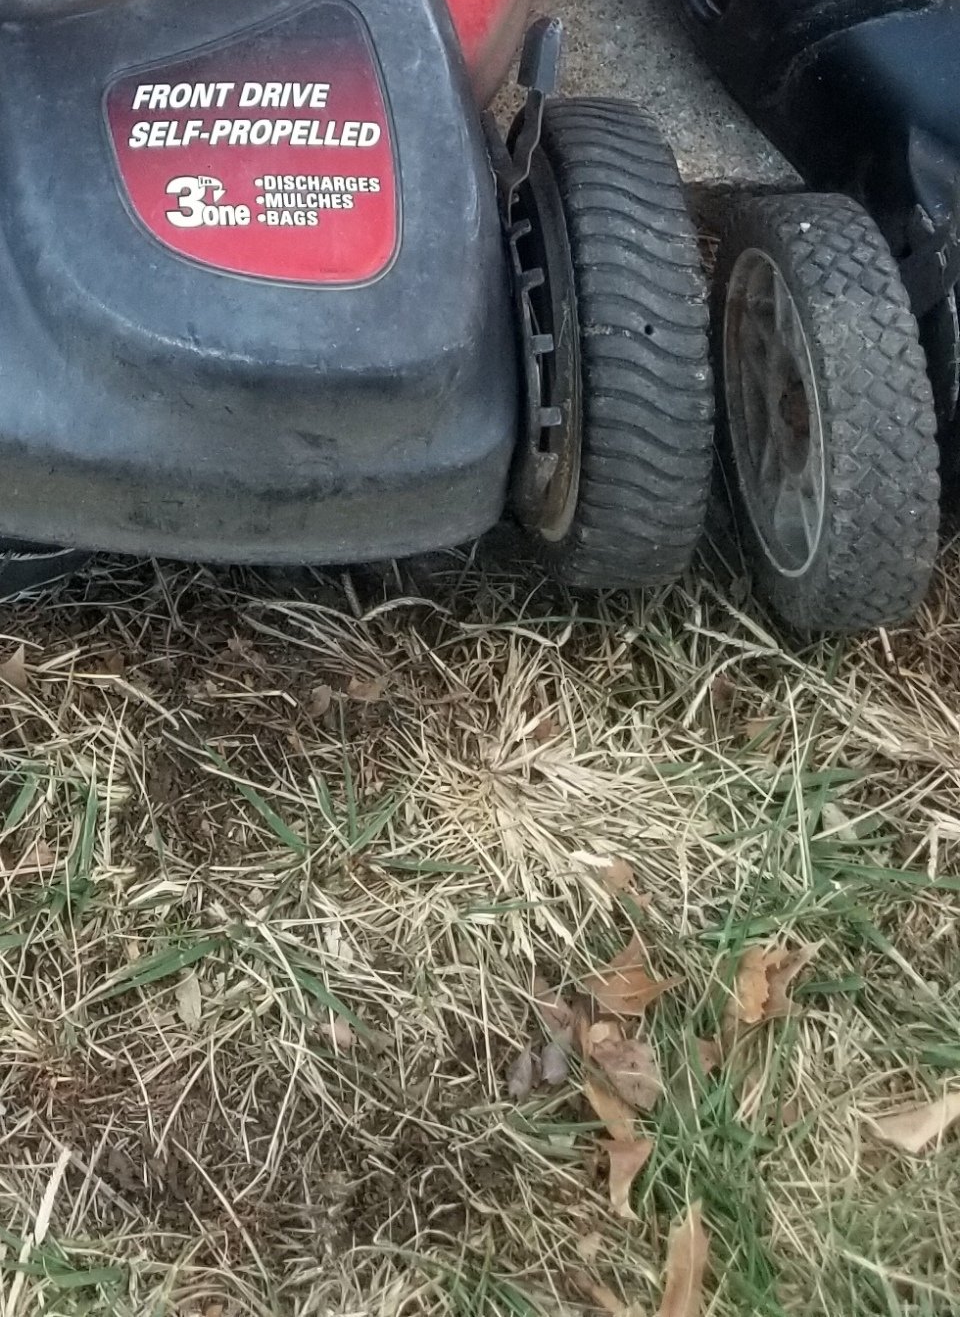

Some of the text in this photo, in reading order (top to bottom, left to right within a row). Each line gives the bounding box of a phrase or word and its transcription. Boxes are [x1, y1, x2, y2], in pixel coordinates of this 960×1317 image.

[131, 82, 330, 110] FRONT DRIVE
[128, 119, 381, 148] SELF-PROPELLED
[263, 175, 381, 192] DISCHARGES
[165, 176, 206, 228] 3
[202, 204, 250, 226] one
[264, 193, 354, 209] MULCHES
[266, 210, 319, 226] BAGS
